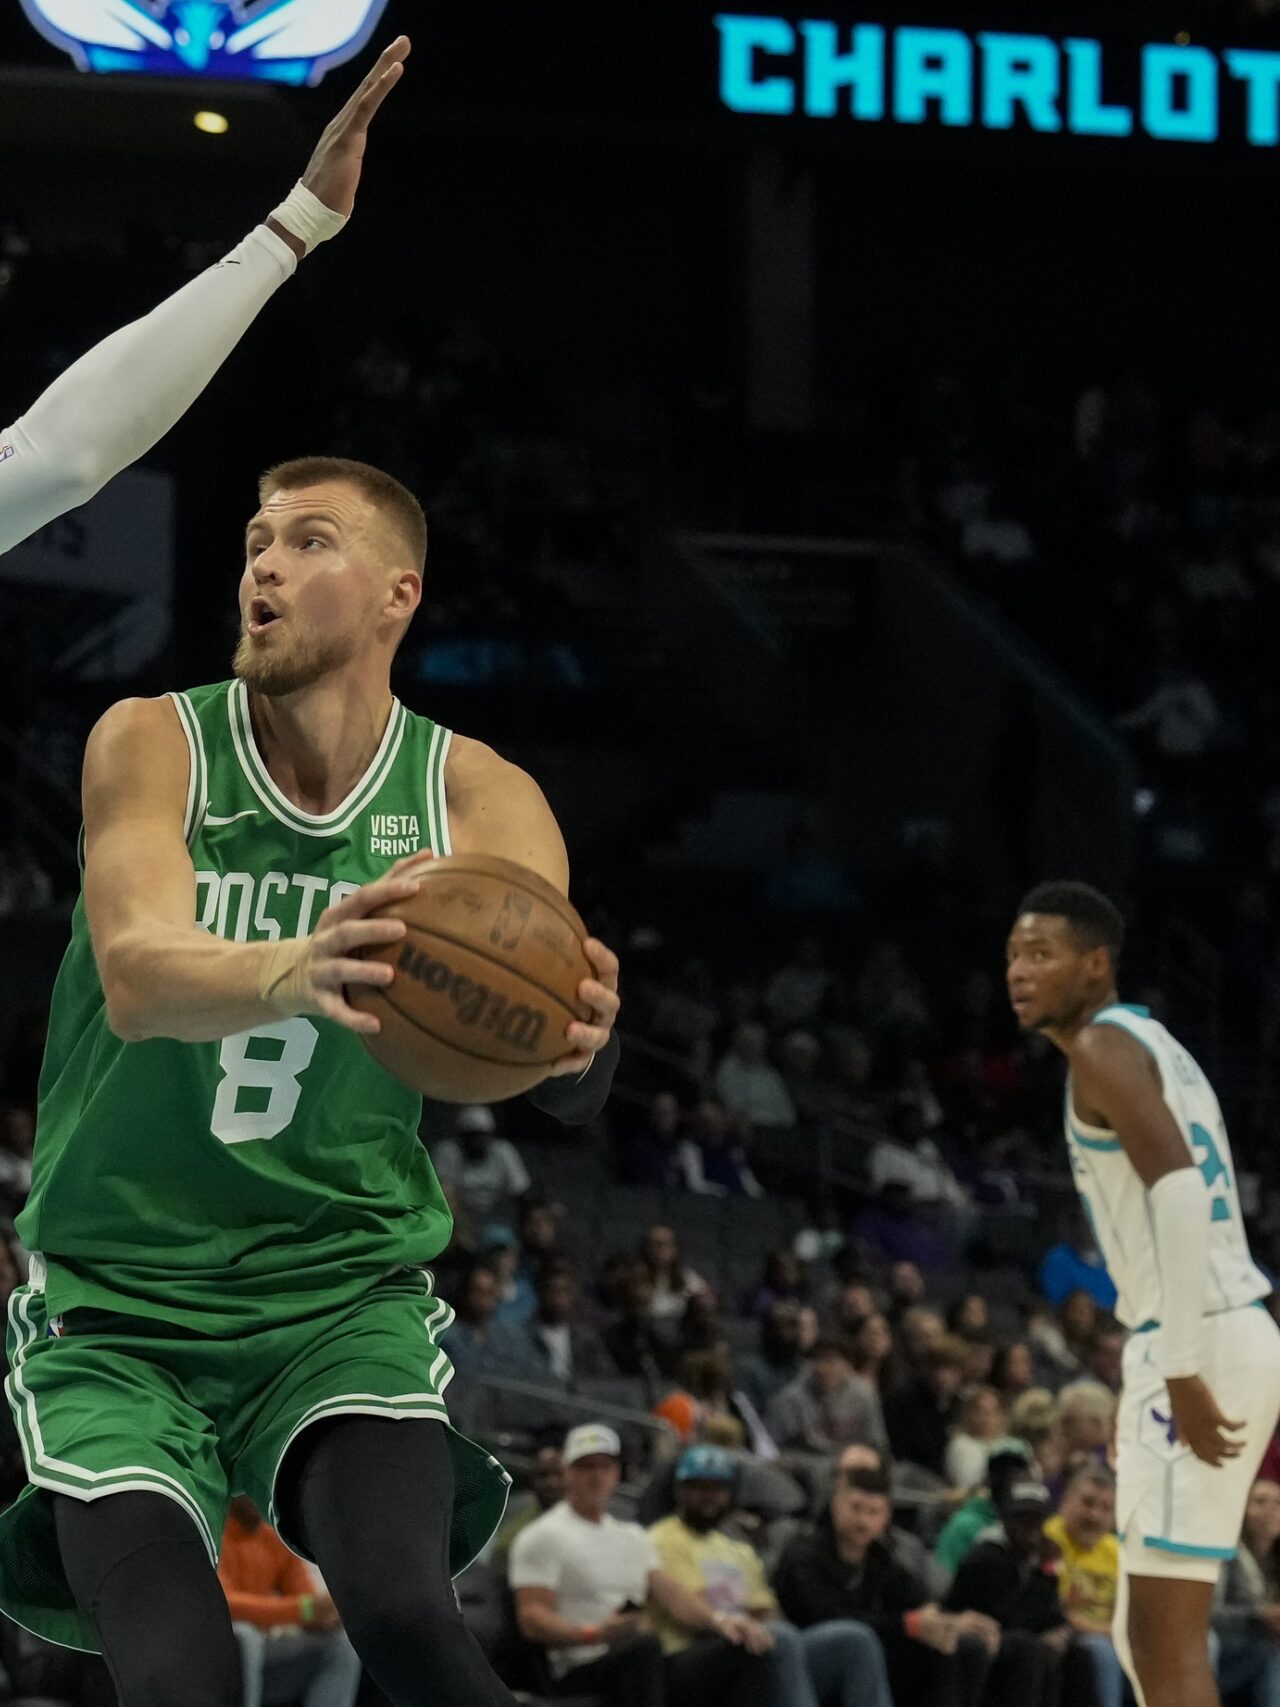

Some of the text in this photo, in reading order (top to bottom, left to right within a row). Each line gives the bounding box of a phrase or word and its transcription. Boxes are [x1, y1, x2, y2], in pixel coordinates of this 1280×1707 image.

[712, 13, 1280, 147] CHARLOT
[370, 814, 420, 836] VISTA
[370, 835, 420, 856] PRINT
[209, 1016, 320, 1145] 8
